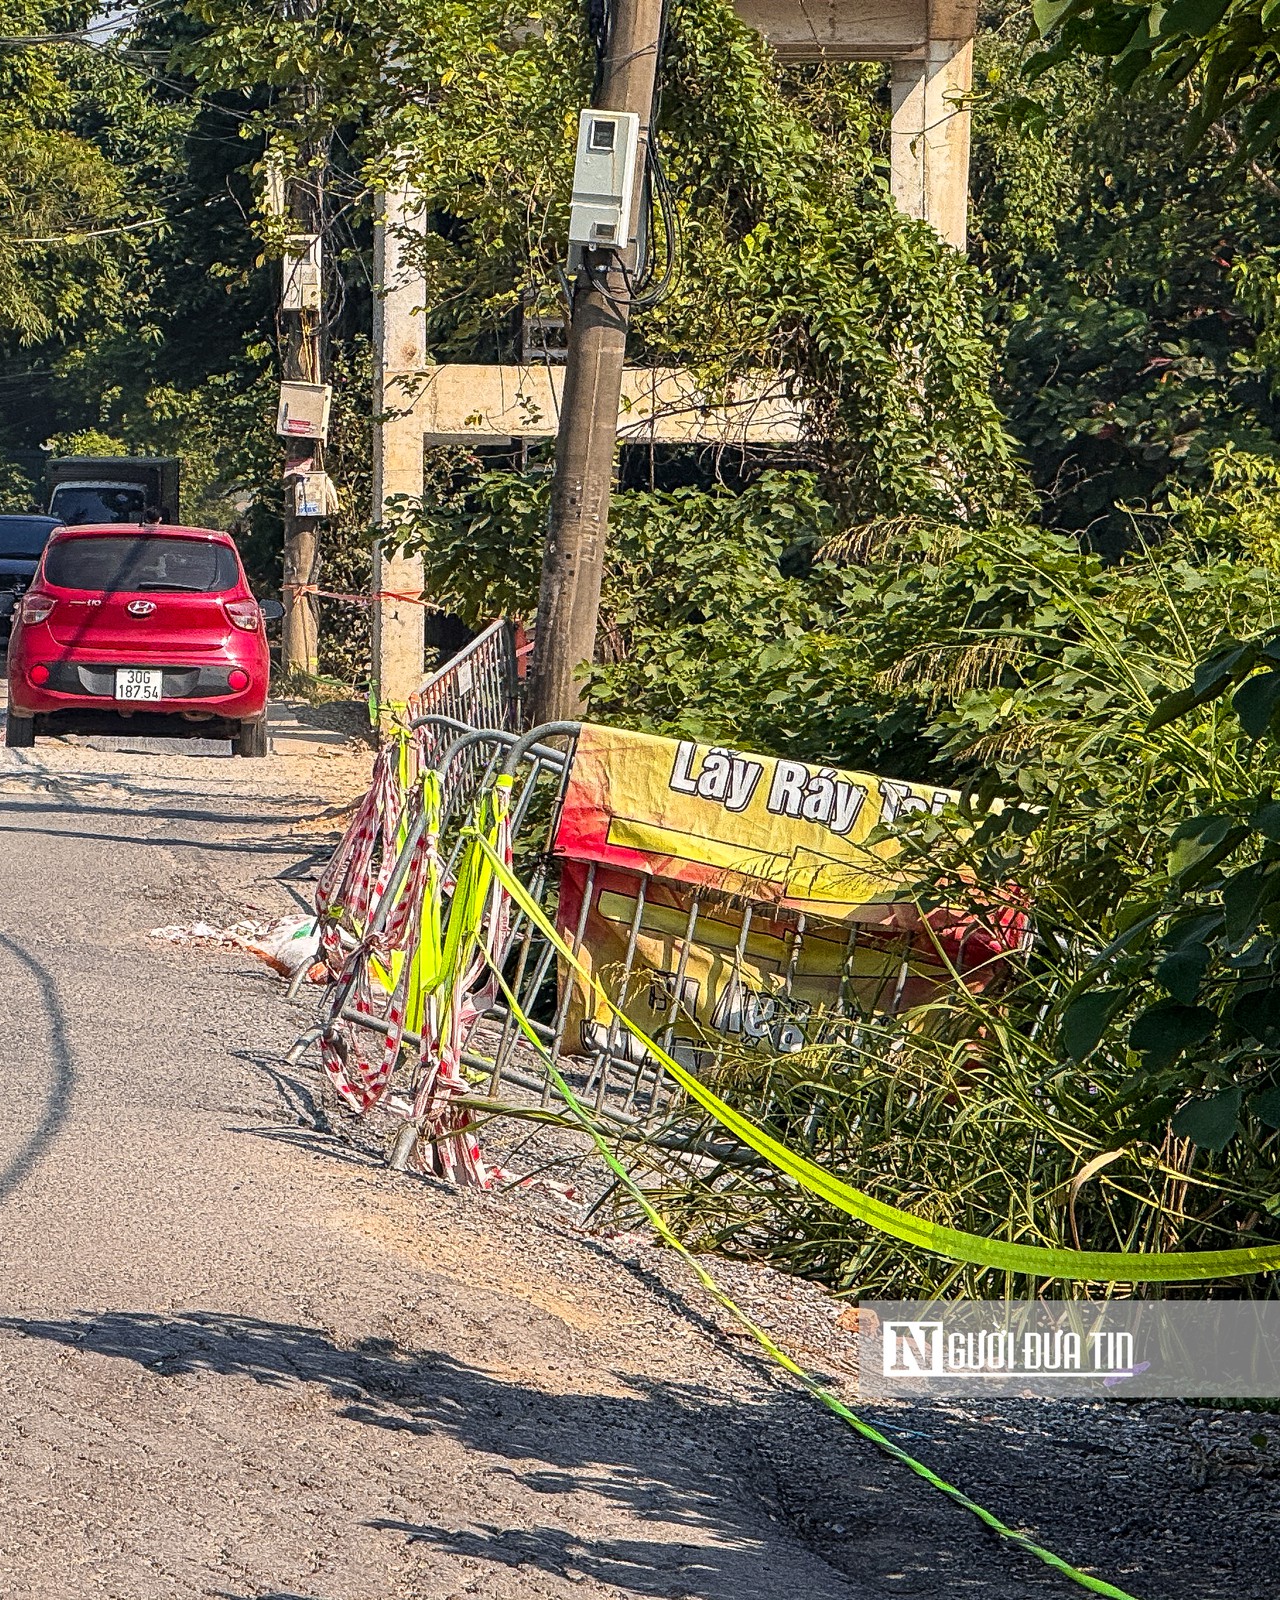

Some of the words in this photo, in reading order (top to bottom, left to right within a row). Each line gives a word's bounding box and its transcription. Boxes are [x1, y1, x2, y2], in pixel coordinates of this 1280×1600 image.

[127, 670, 151, 684] 30G
[119, 684, 159, 699] 187.54
[766, 759, 869, 835] Ráy
